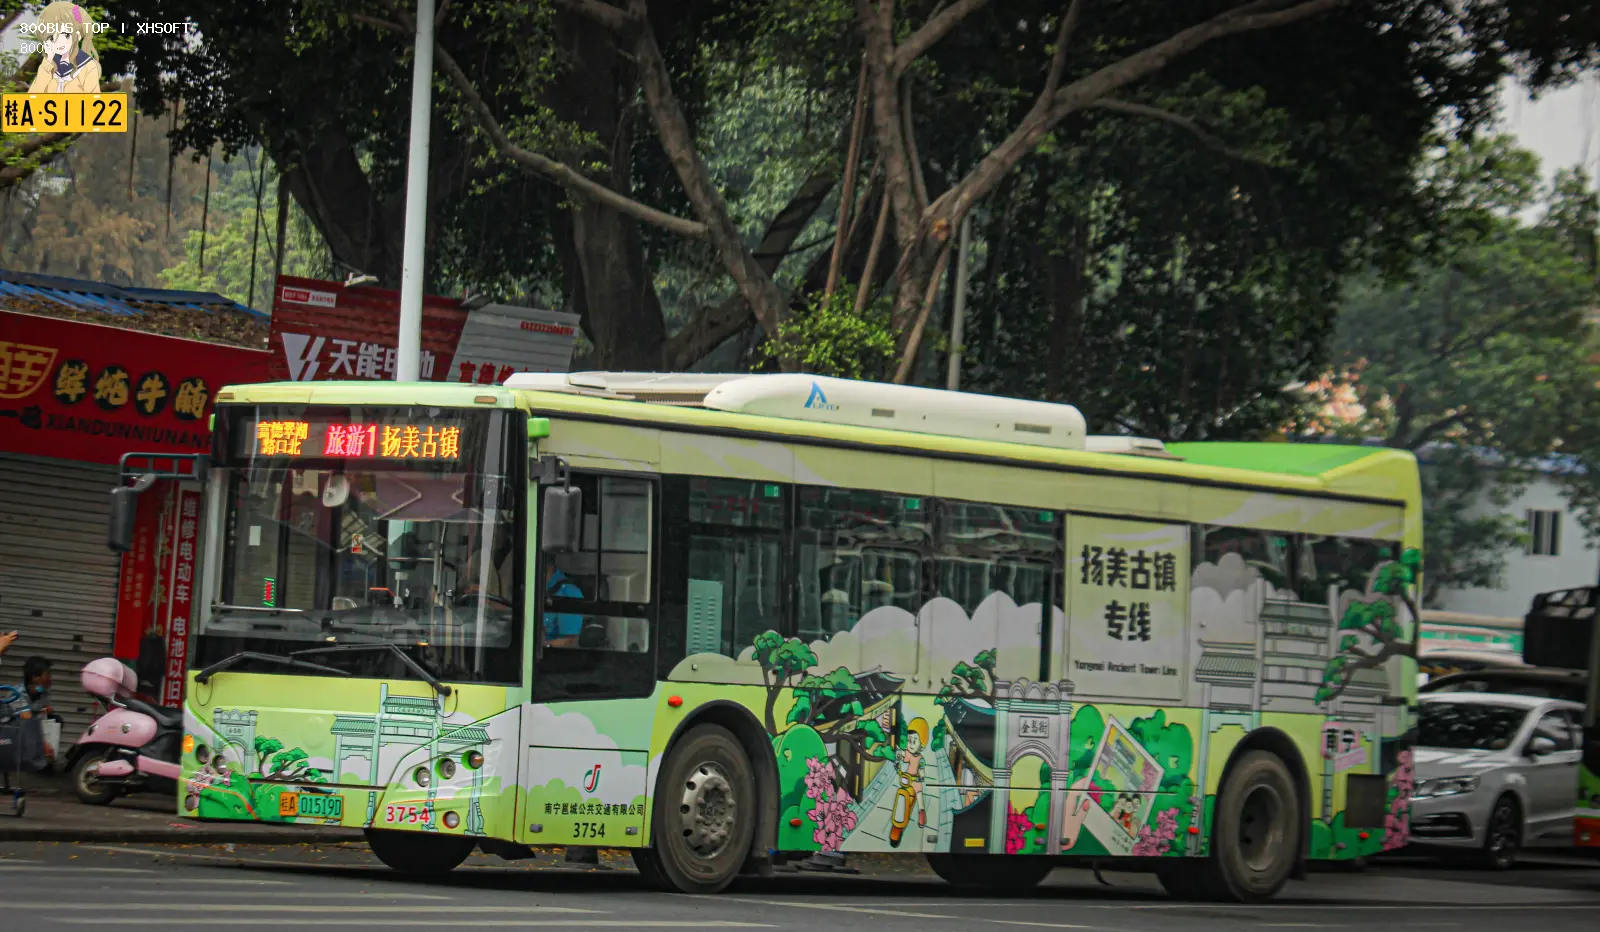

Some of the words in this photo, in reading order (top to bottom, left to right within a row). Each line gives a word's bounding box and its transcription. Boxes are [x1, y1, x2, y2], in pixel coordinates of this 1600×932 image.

[380, 425, 460, 459] 扬美古镇
[1081, 544, 1176, 592] 扬美古镇
[1105, 599, 1151, 642] 专线
[386, 805, 430, 824] 3754
[544, 803, 644, 816] 南宁邕城公共交通有限公司
[573, 822, 606, 839] 3754
